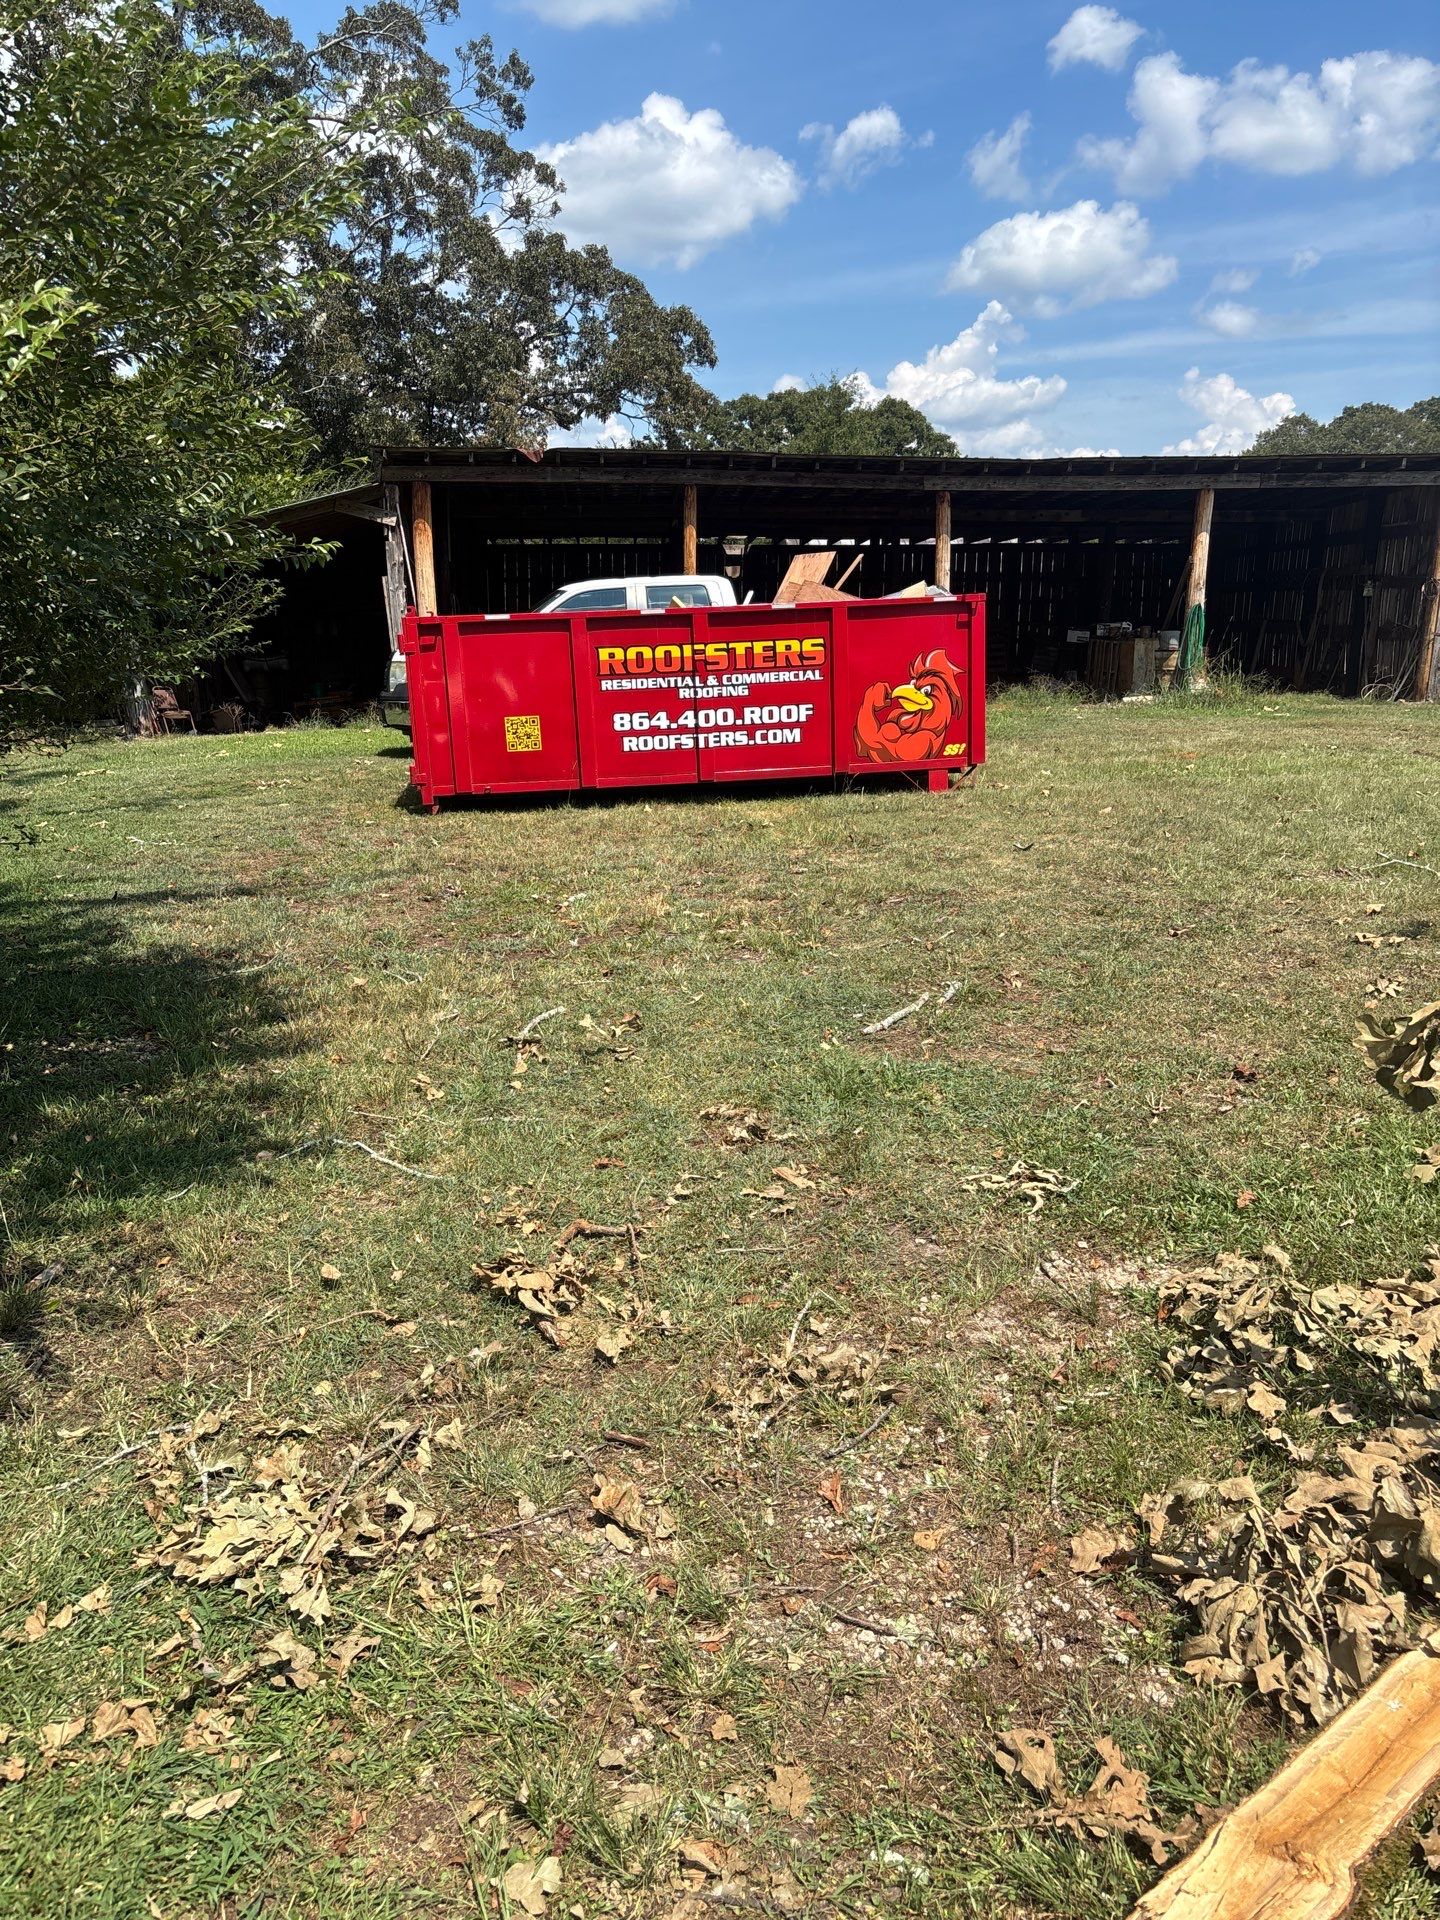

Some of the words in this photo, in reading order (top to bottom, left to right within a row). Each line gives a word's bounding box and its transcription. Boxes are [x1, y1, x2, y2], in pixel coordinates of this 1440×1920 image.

[597, 638, 825, 675] ROOFSTERS
[601, 675, 704, 691] RESIDENTIAL
[706, 675, 719, 686] &
[722, 669, 824, 685] COMMERCIAL
[679, 685, 749, 699] ROOFING
[613, 704, 814, 731] 864.400.ROOF
[622, 728, 801, 752] ROOFSTERS.COM
